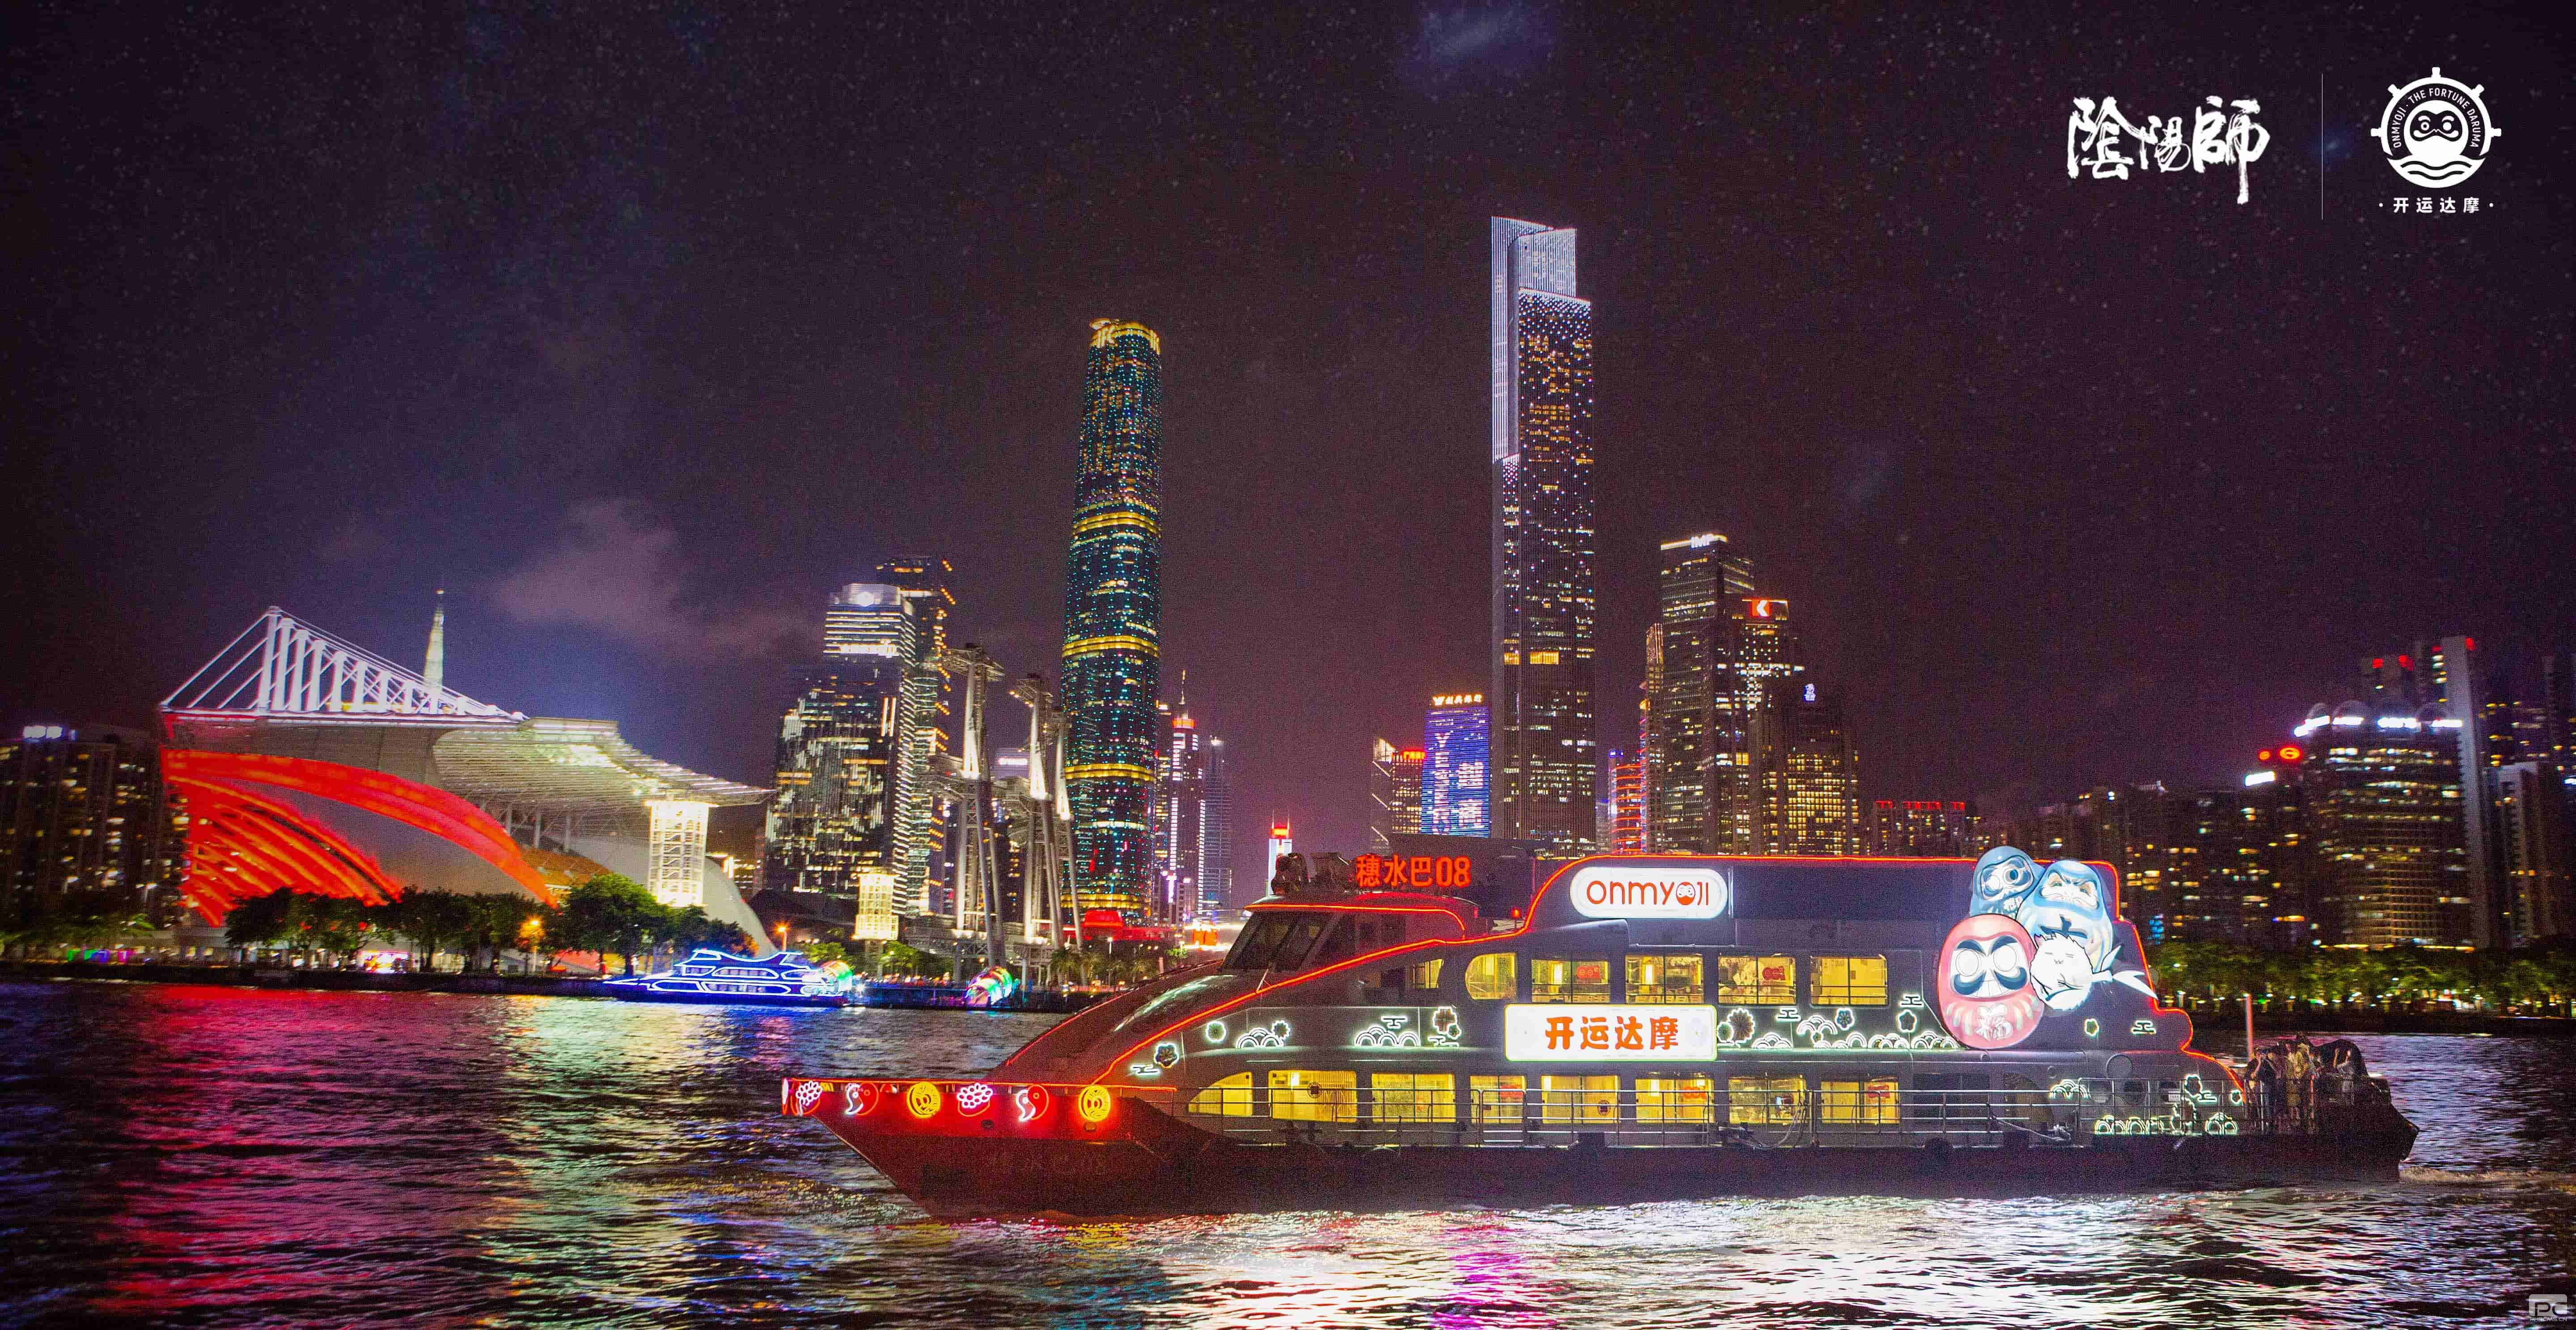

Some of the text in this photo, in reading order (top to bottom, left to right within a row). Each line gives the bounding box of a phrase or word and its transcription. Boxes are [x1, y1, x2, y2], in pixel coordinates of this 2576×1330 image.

[1356, 853, 1471, 887] 穗水巴08
[1545, 1016, 1678, 1050] 开运达摩
